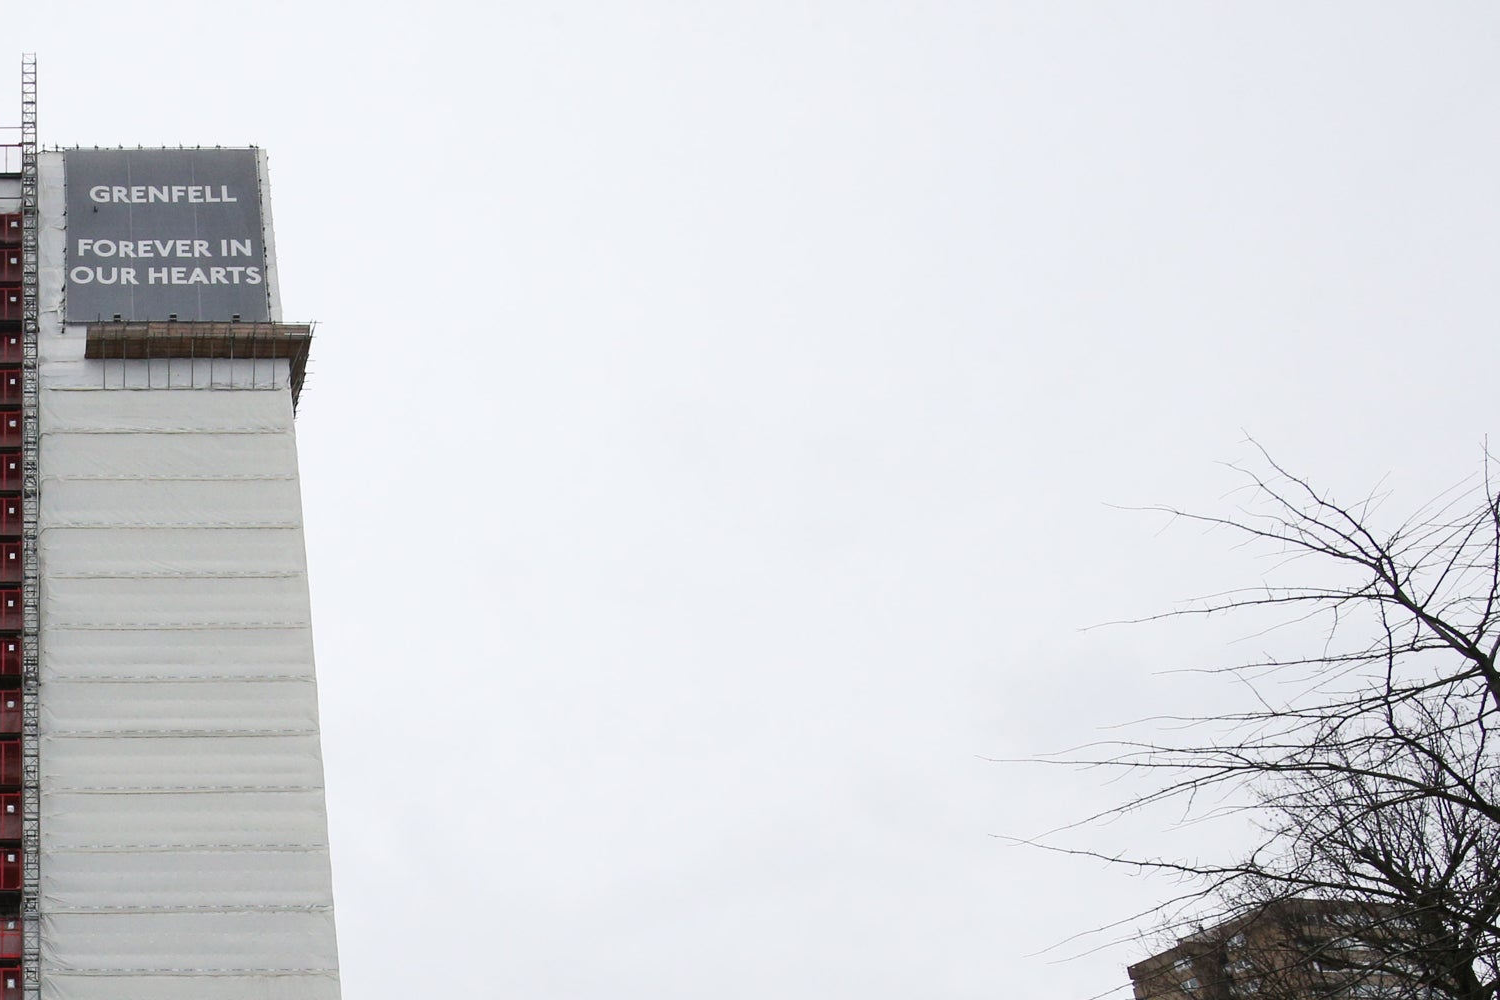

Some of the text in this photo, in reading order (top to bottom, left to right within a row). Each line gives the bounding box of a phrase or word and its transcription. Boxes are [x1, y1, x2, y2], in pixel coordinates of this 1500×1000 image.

[89, 185, 238, 204] GRENFELL
[77, 238, 252, 258] FOREVER IN
[69, 265, 262, 285] OUR HEARTS
